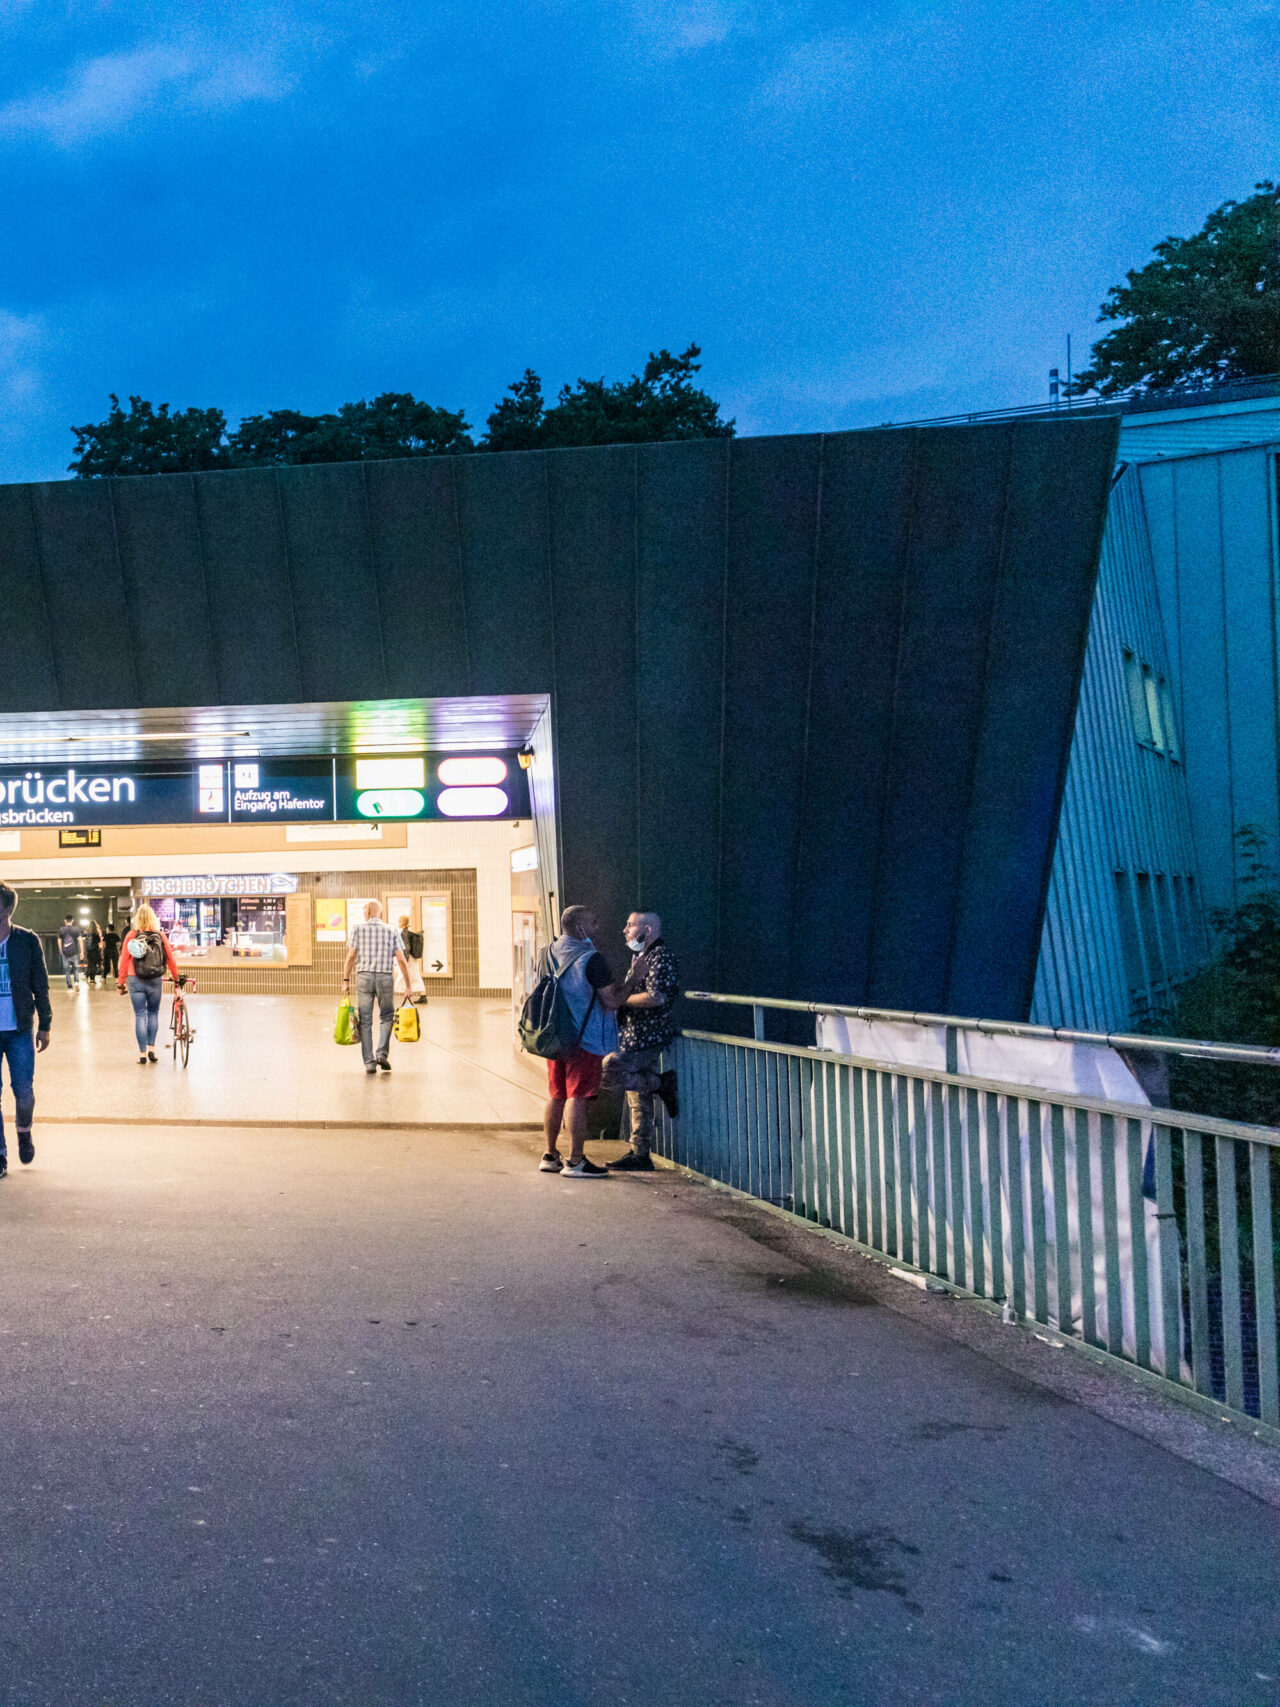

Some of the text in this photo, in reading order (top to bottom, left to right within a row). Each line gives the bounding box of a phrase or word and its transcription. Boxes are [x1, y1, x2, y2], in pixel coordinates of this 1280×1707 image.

[235, 790, 290, 802] Aufzug am
[235, 799, 325, 812] Eingang Hafentor
[142, 876, 269, 894] FISCHBRÖTCHEN
